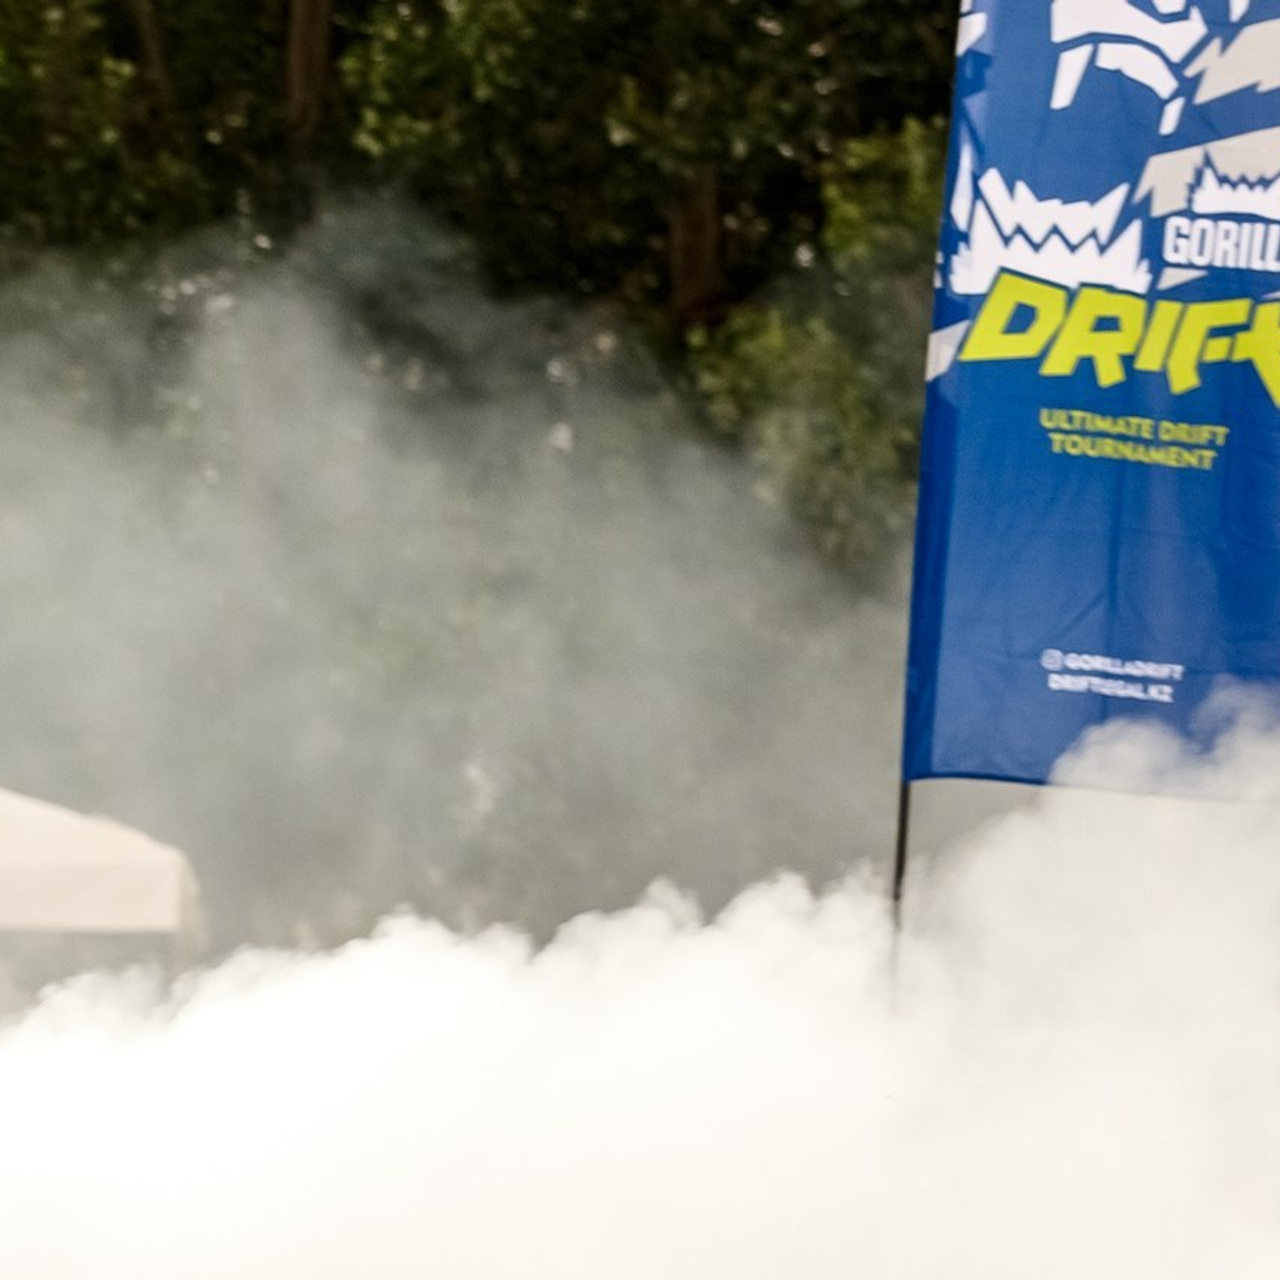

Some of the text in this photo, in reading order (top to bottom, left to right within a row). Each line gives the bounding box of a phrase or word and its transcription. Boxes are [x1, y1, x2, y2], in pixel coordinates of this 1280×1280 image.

[1039, 407, 1230, 446] ULTIMATE DRIFT
[1047, 432, 1218, 470] TOURNAMENT
